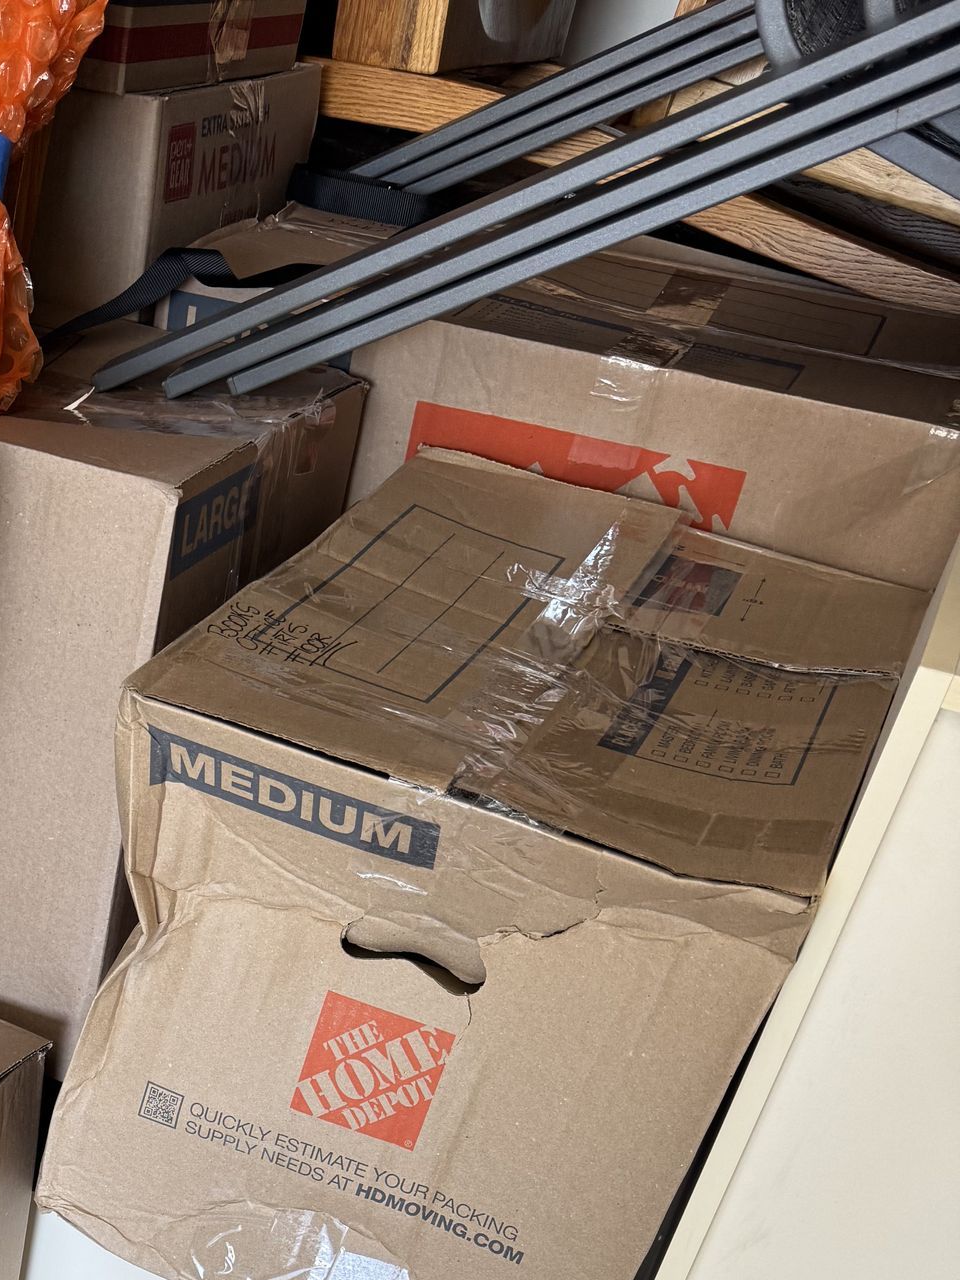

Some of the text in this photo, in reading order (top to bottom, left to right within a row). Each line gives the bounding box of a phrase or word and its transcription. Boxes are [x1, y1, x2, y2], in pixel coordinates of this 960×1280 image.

[201, 112, 228, 138] EXTRA
[197, 131, 277, 197] MEDIUM
[207, 602, 261, 639] BOOKS
[770, 752, 788, 769] BATH
[169, 741, 417, 855] MEDIUM
[323, 1021, 384, 1061] THE
[295, 1026, 451, 1119] HOME
[342, 1077, 435, 1132] DEPOT
[185, 1120, 525, 1264] SUPPLY NEEDS AT HDMOVING.COM
[190, 1102, 519, 1241] QUICKLY ESTIMATE YOUR PACKING
